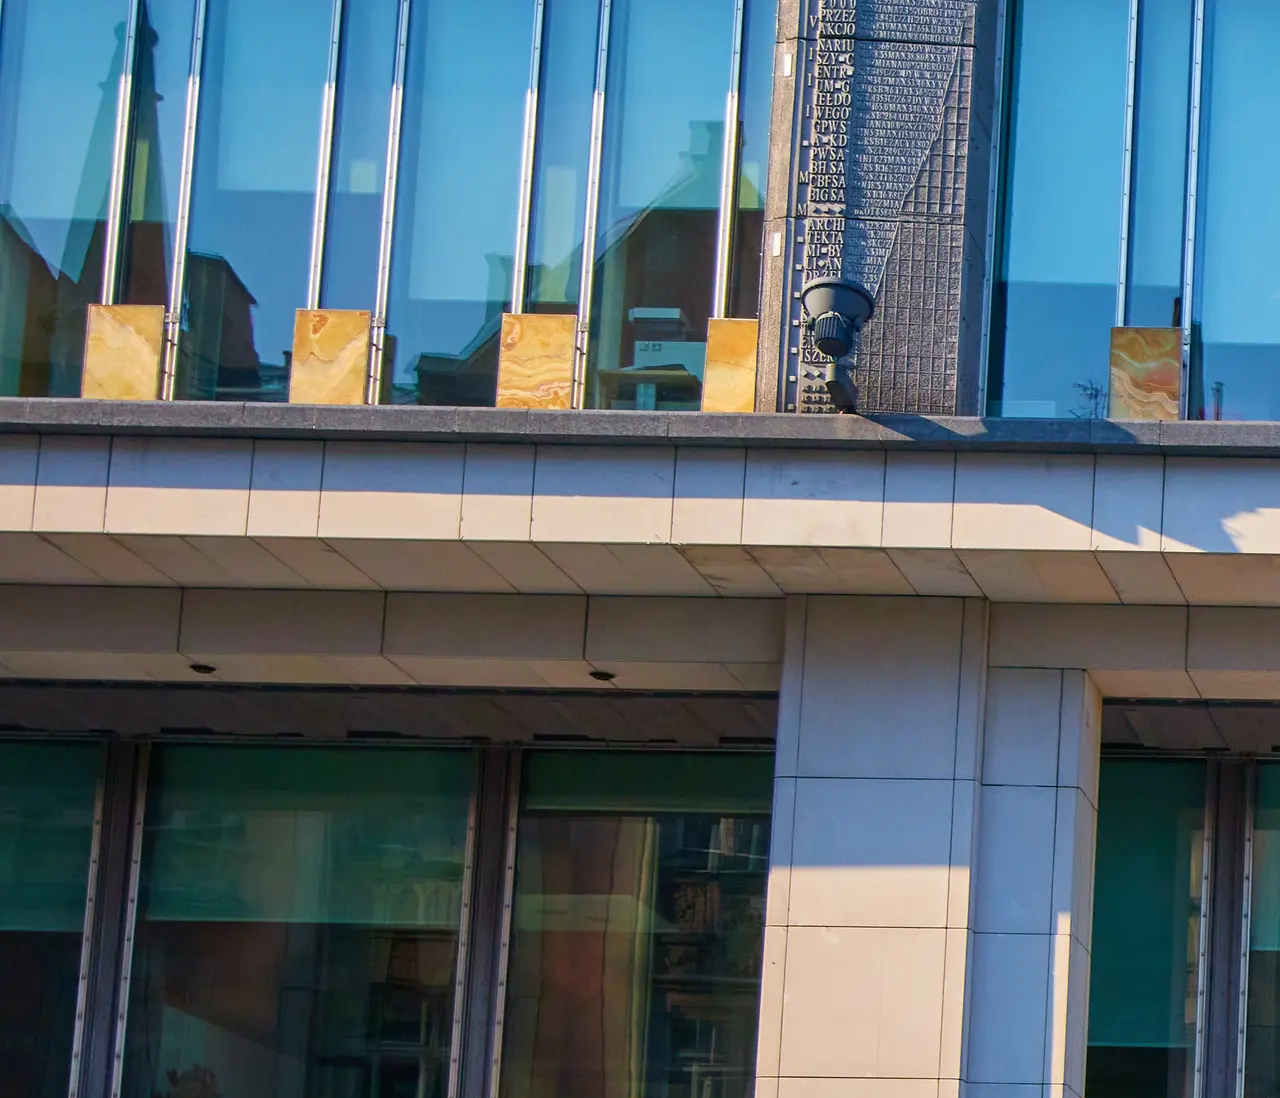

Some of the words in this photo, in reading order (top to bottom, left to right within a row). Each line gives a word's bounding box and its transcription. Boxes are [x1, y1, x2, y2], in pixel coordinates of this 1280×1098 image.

[820, 9, 856, 22] PRZEZ
[818, 39, 855, 52] NARIU
[814, 106, 850, 119] WEGO
[808, 218, 845, 231] ARCHI
[807, 231, 844, 244] TEKTA
